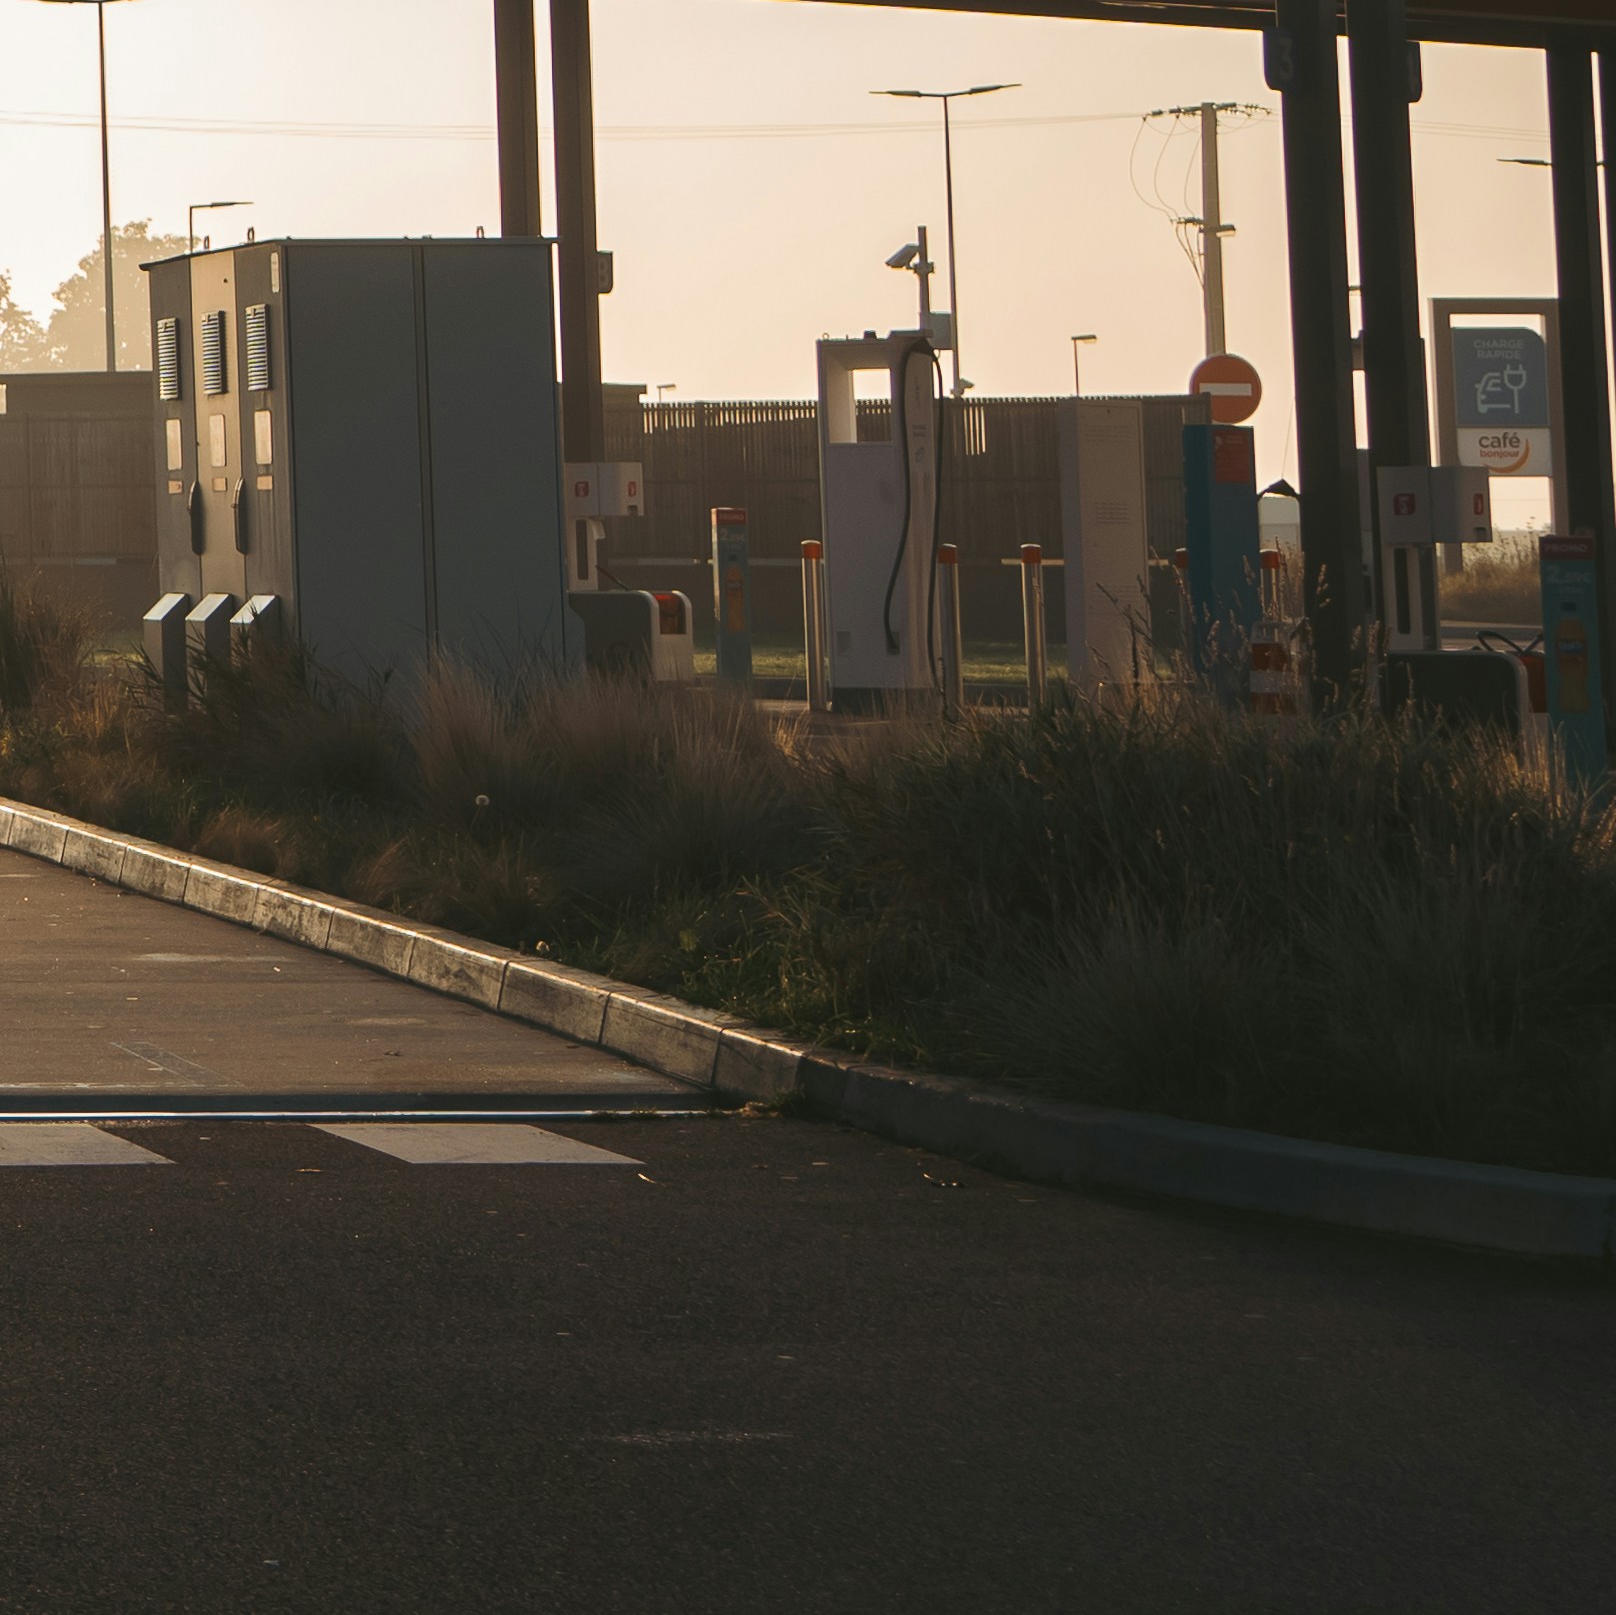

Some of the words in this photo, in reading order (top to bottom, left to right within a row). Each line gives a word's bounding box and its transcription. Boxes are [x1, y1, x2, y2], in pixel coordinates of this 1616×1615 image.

[1473, 339, 1524, 349] CHARGE
[1476, 349, 1522, 360] RAPIDE
[1478, 432, 1521, 449] café
[1479, 449, 1520, 459] bonjour
[1543, 543, 1589, 553] PROMO
